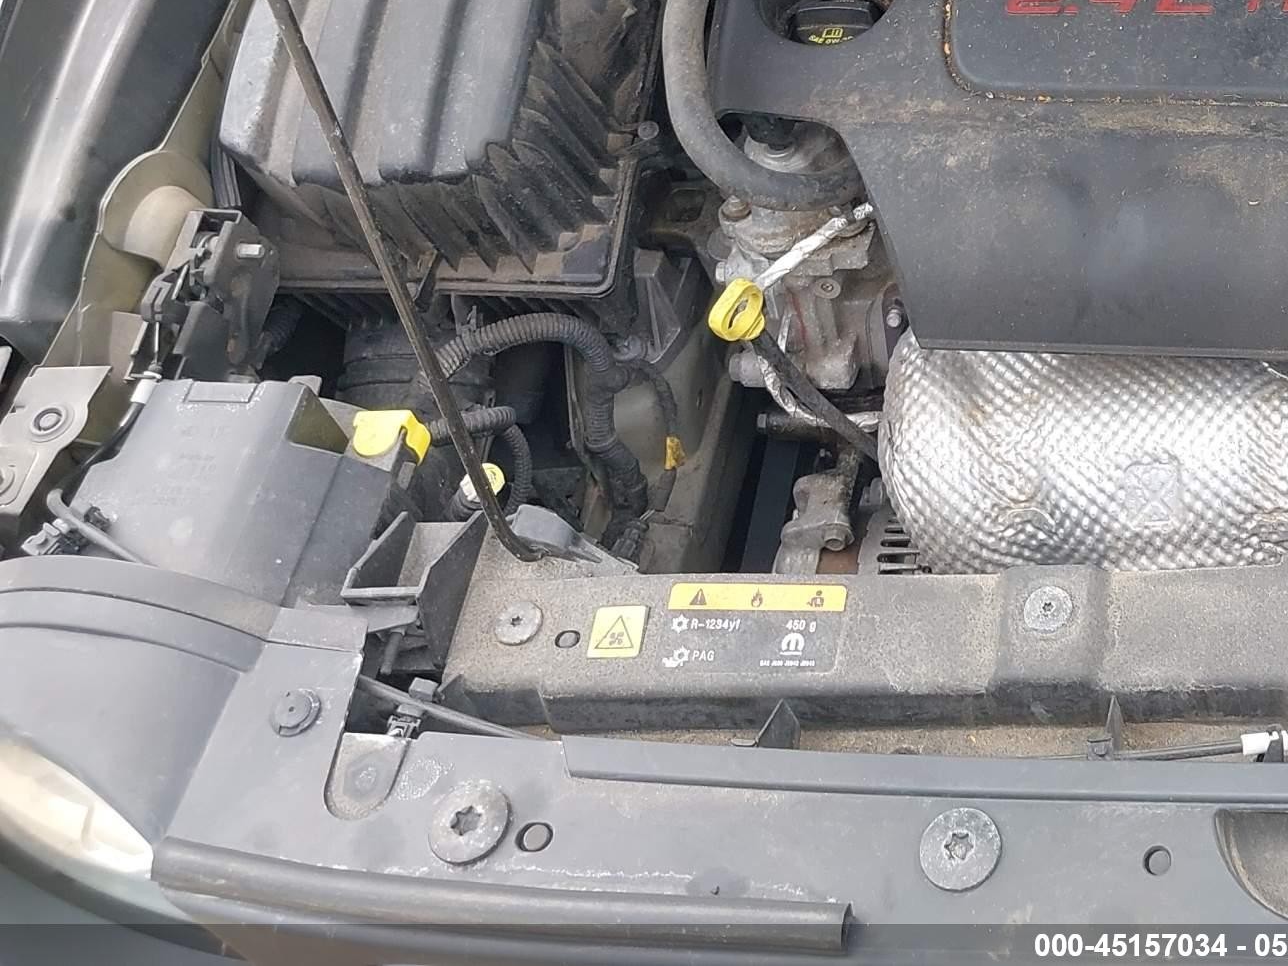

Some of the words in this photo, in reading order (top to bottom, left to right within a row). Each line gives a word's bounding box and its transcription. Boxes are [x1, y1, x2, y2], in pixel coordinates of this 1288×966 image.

[690, 618, 741, 632] R-1234yf
[785, 619, 806, 631] 450
[809, 621, 817, 633] g
[692, 649, 715, 662] PAG
